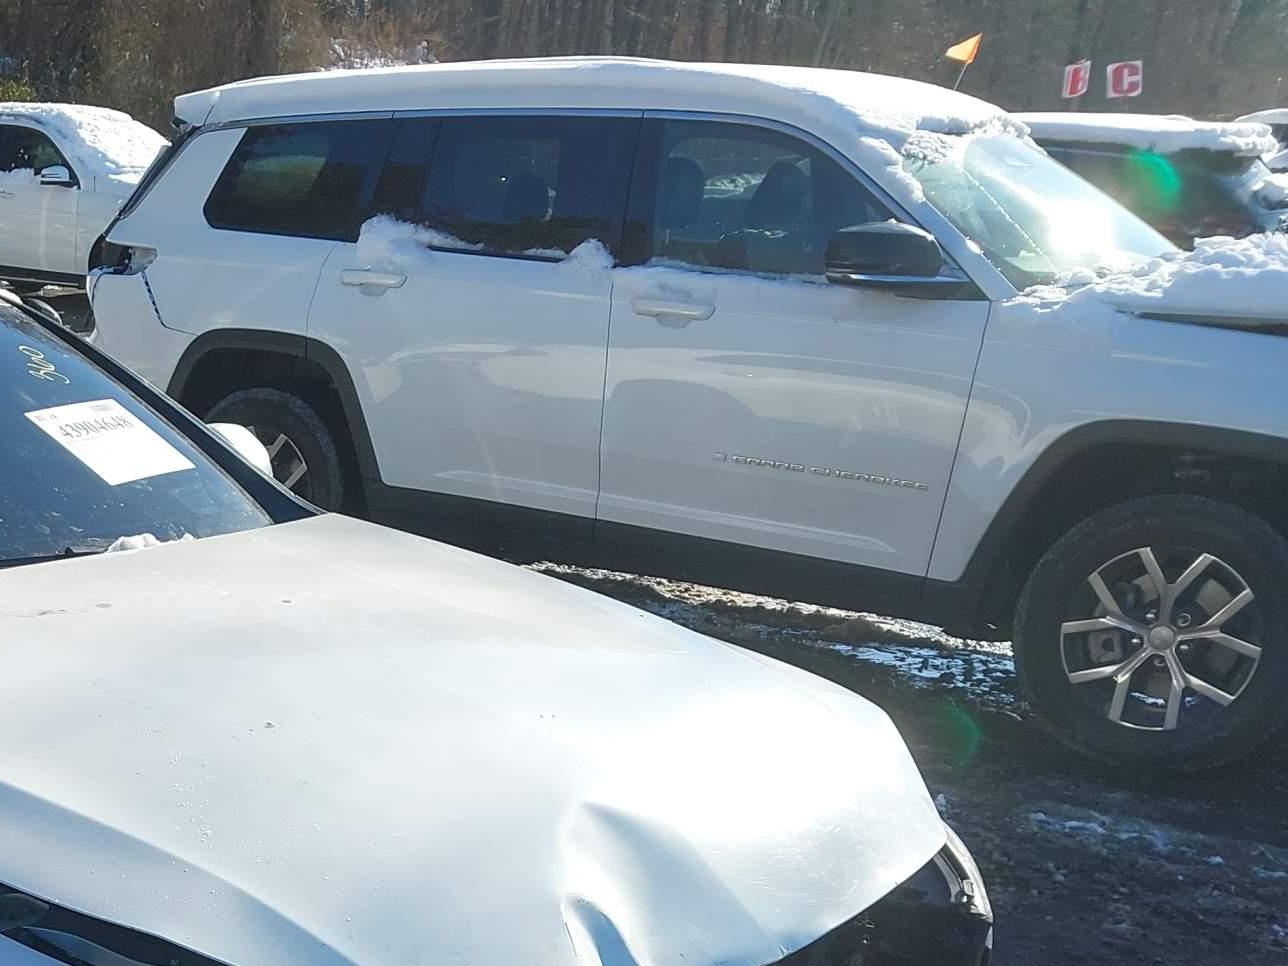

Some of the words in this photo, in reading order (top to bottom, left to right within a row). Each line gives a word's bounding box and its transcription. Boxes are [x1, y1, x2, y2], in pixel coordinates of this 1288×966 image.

[1112, 63, 1141, 95] C
[58, 415, 135, 439] 43904648
[732, 454, 805, 473] GRAND
[810, 466, 929, 491] CHEROKEE
